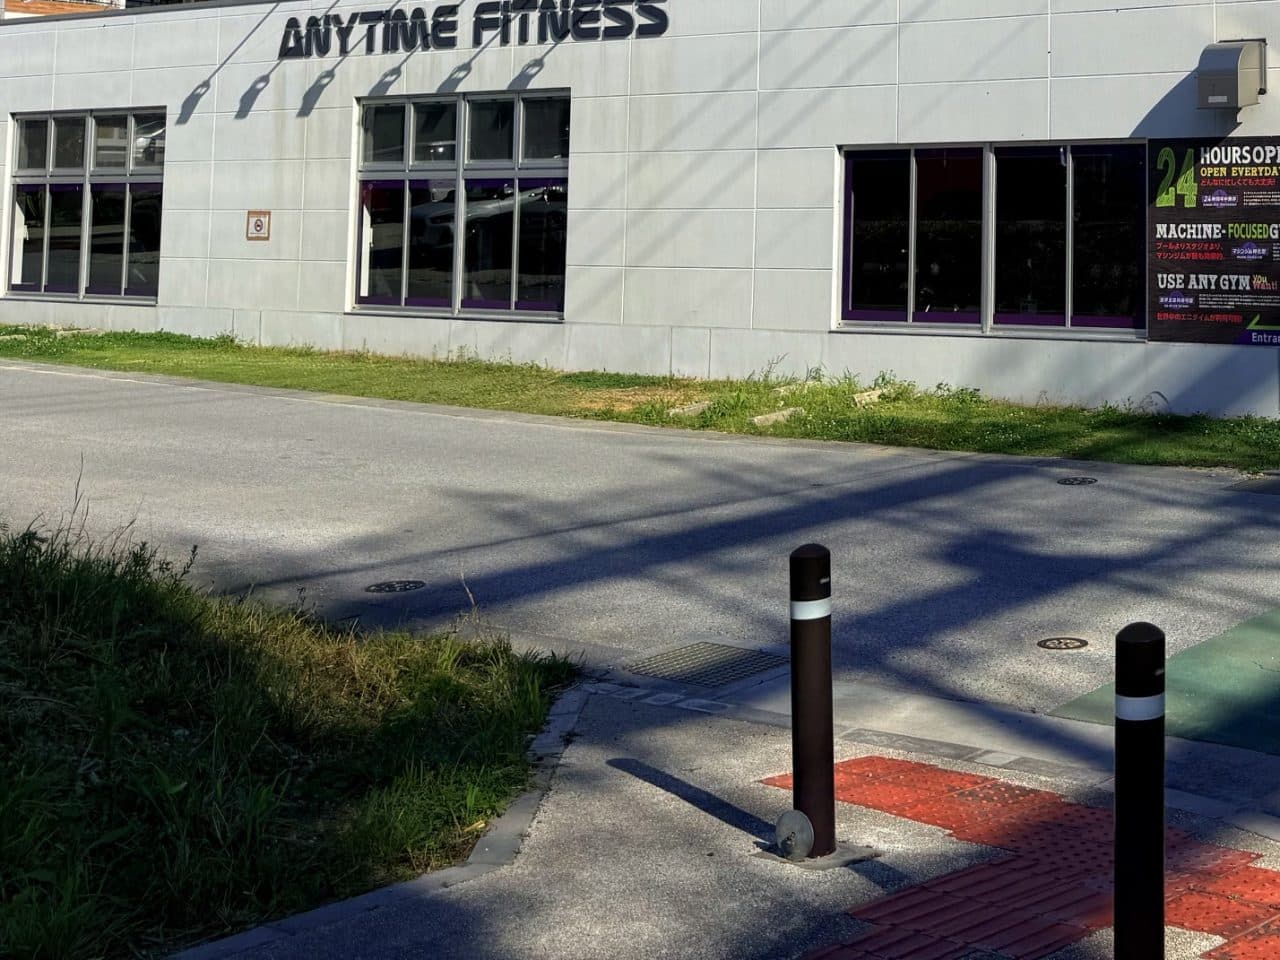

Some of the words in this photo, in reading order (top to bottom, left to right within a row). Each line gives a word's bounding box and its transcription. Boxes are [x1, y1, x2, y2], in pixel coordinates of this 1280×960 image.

[278, 4, 459, 58] ANYTIME
[1155, 147, 1198, 208] 24
[1200, 146, 1250, 164] HOURS
[1200, 167, 1227, 177] OPEN
[1228, 223, 1269, 239] FOCUSED
[1157, 274, 1184, 289] USE
[1187, 274, 1218, 289] ANY
[1219, 275, 1250, 290] GYM
